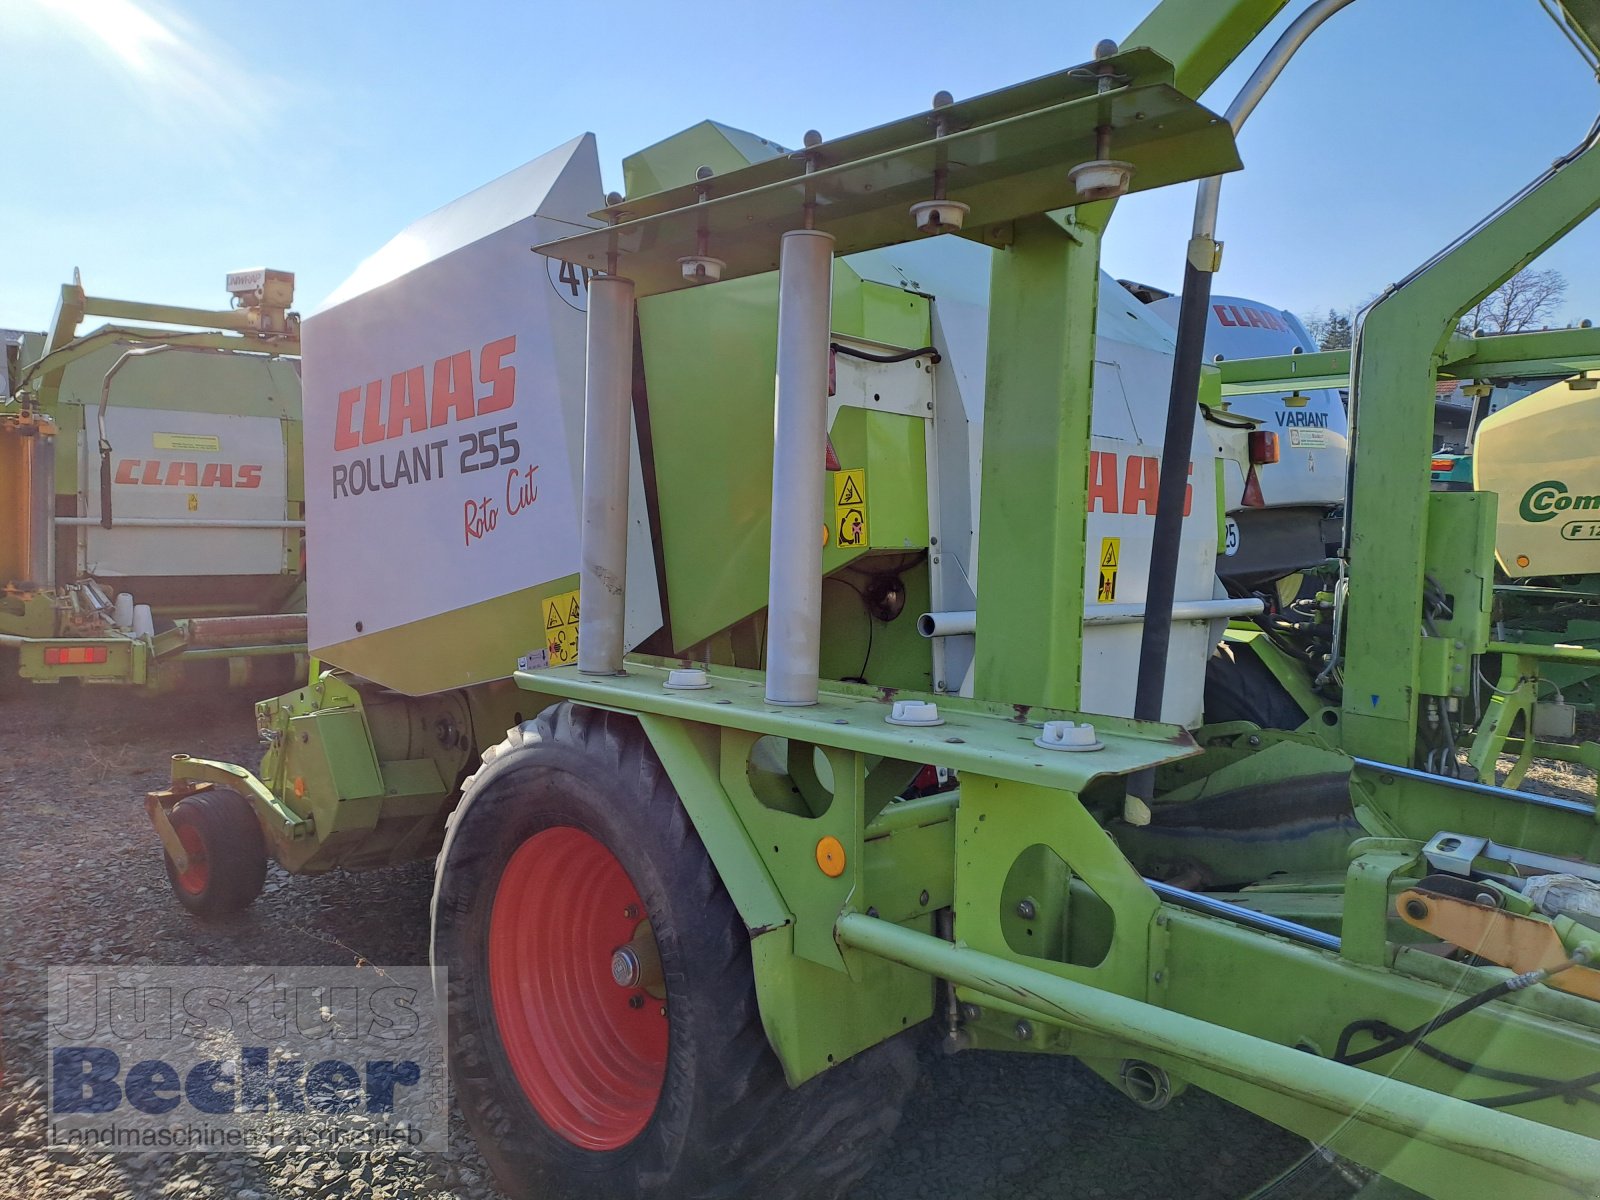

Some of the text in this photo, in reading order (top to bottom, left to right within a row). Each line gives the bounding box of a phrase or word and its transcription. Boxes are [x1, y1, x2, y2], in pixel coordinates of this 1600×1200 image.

[334, 335, 516, 451] CLAAS
[1275, 411, 1328, 428] VARIANT
[114, 459, 263, 488] CLAAS
[333, 421, 520, 499] ROLLANT 255
[464, 464, 539, 546] Roto Cut
[1570, 525, 1583, 537] F
